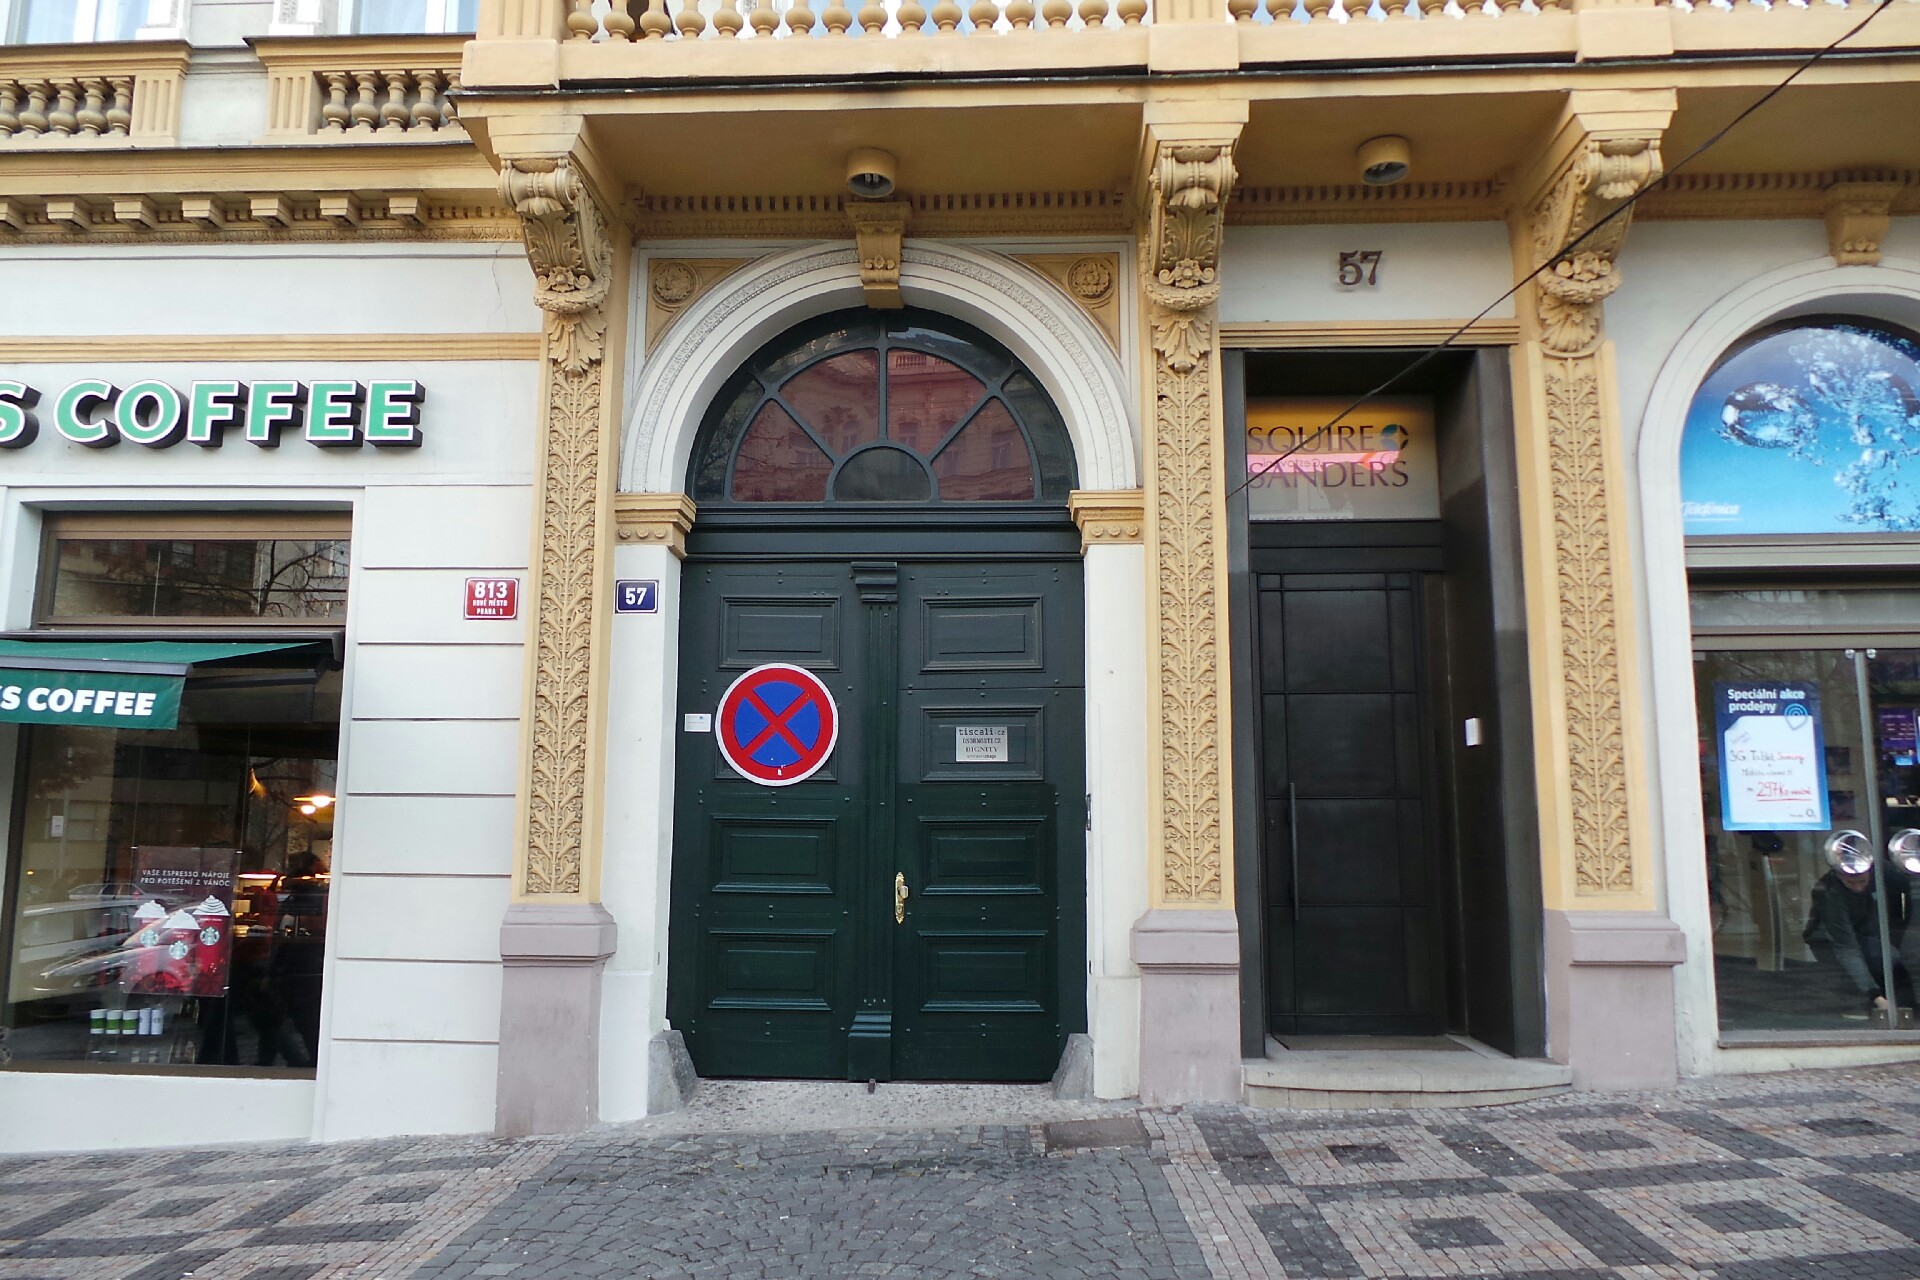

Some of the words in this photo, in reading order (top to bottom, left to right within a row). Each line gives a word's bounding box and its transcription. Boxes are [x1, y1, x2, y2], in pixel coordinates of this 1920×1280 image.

[1339, 250, 1383, 285] 57
[53, 379, 425, 448] COFFEE
[1247, 425, 1374, 453] SQUIRE
[1247, 461, 1409, 489] SANDERS
[474, 581, 508, 599] 813
[625, 587, 648, 606] 57
[476, 607, 497, 615] PRAHA
[27, 687, 156, 717] COFFEE
[1727, 688, 1777, 702] Speciální
[1779, 688, 1806, 700] akce
[1728, 701, 1777, 714] prodejny
[958, 727, 1006, 736] tiscali.cz
[140, 876, 155, 885] PRO
[157, 876, 194, 885] POTĚŠENÍ
[203, 877, 231, 887] VÁNOC
[142, 868, 160, 876] VAŠE
[162, 869, 199, 878] ESPRESSO
[201, 870, 231, 879] NÁPOJE
